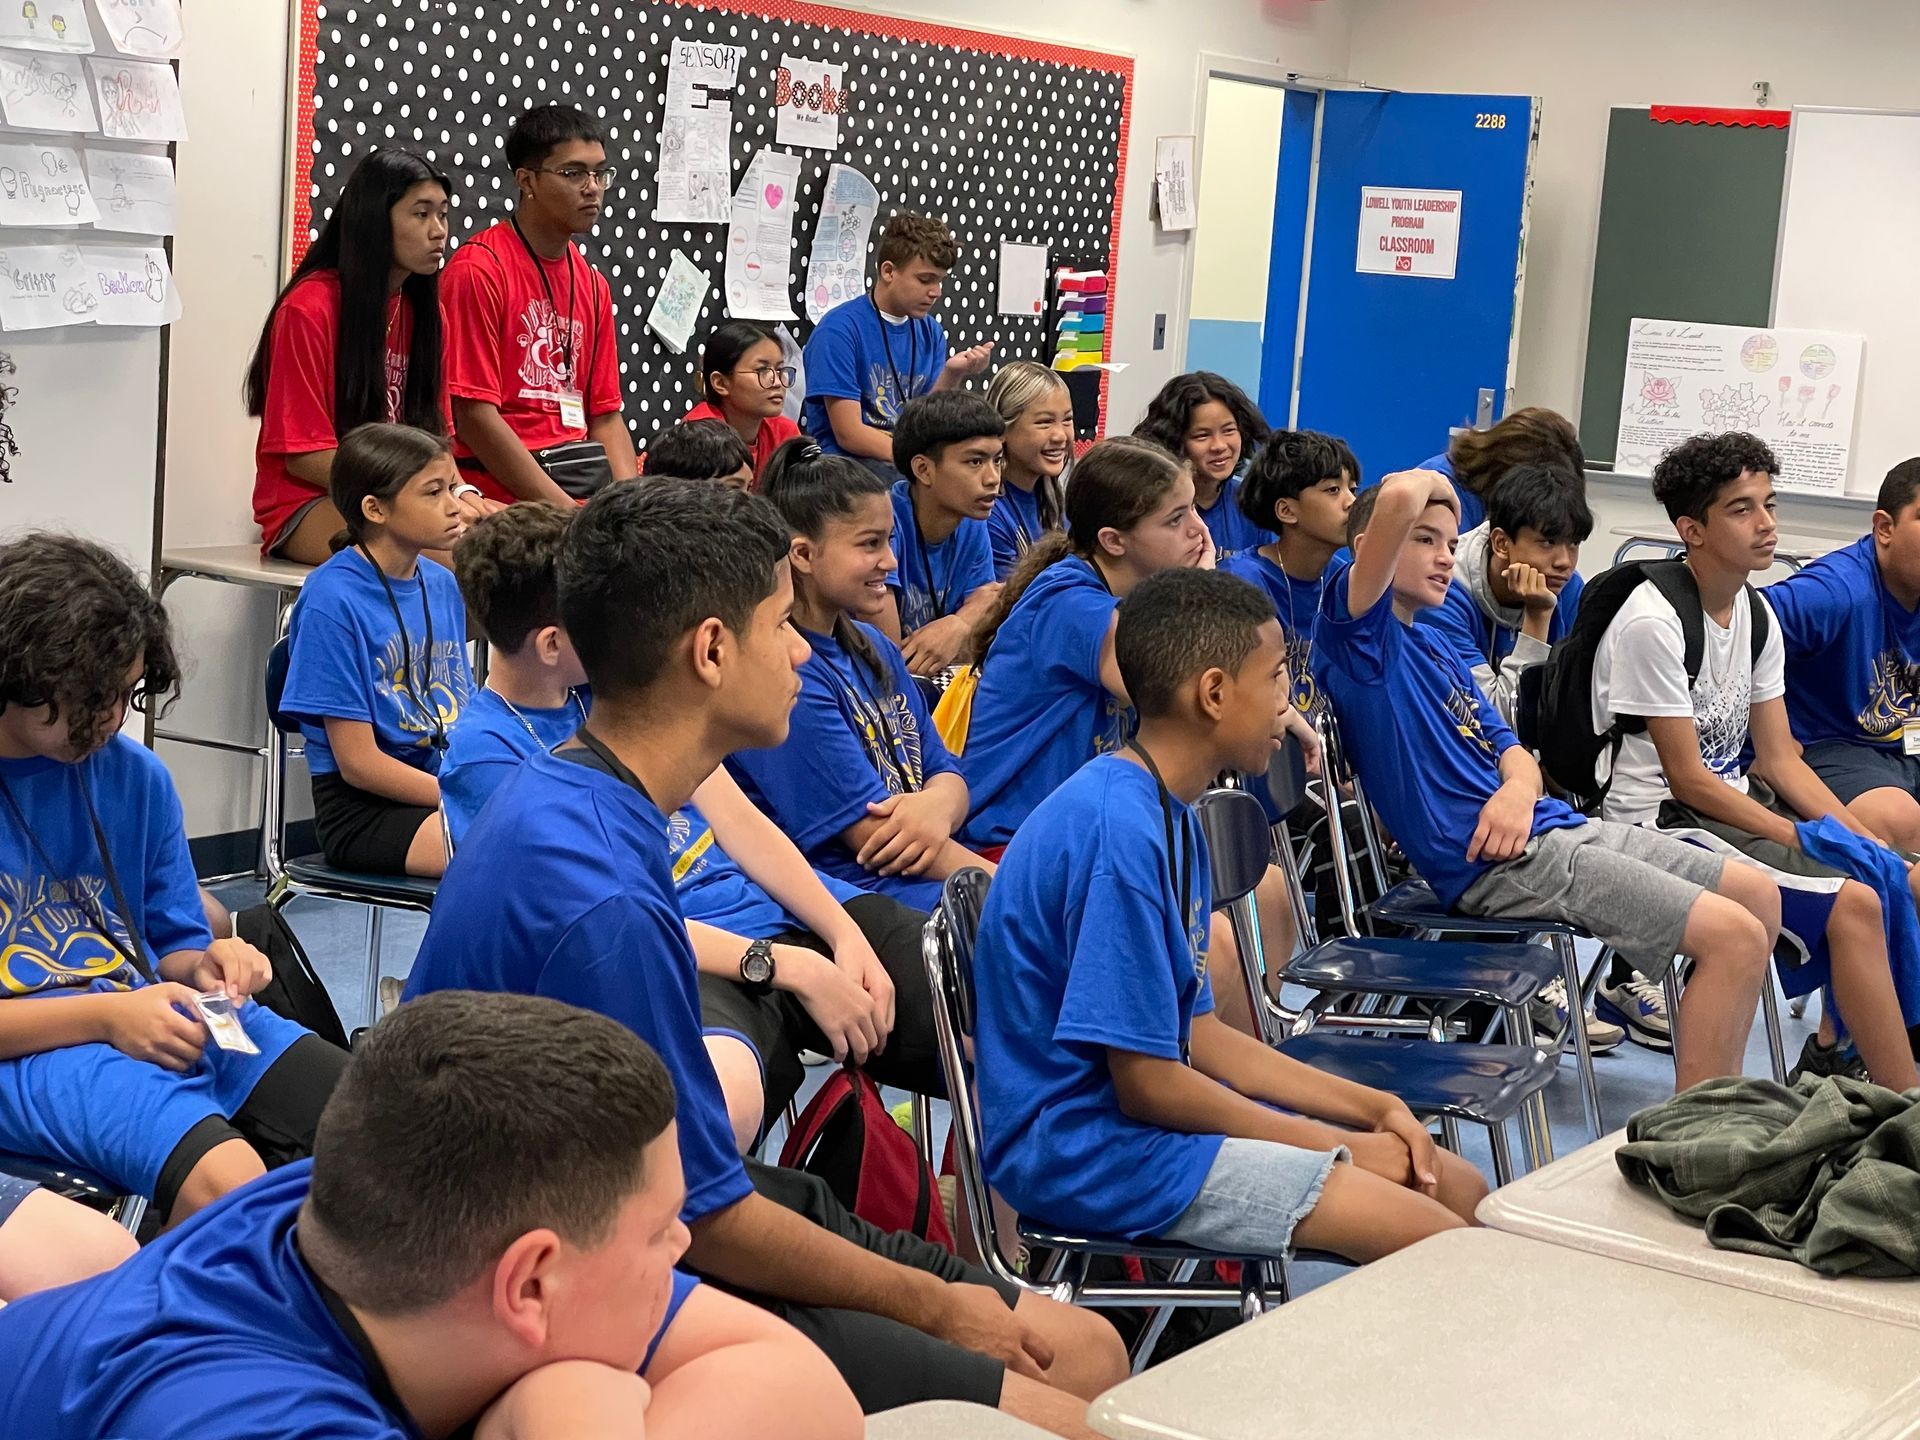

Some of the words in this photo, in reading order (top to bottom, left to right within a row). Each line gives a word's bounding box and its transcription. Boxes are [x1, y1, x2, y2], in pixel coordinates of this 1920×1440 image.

[680, 46, 736, 73] SENSOR
[775, 67, 848, 115] Books
[1475, 113, 1506, 129] 2288
[1366, 196, 1390, 210] LOWELL
[1391, 197, 1412, 211] YOUTH
[1413, 199, 1457, 213] LEADERSHIP
[1391, 216, 1424, 229] PROGRAM
[1379, 235, 1435, 255] CLASSROOM
